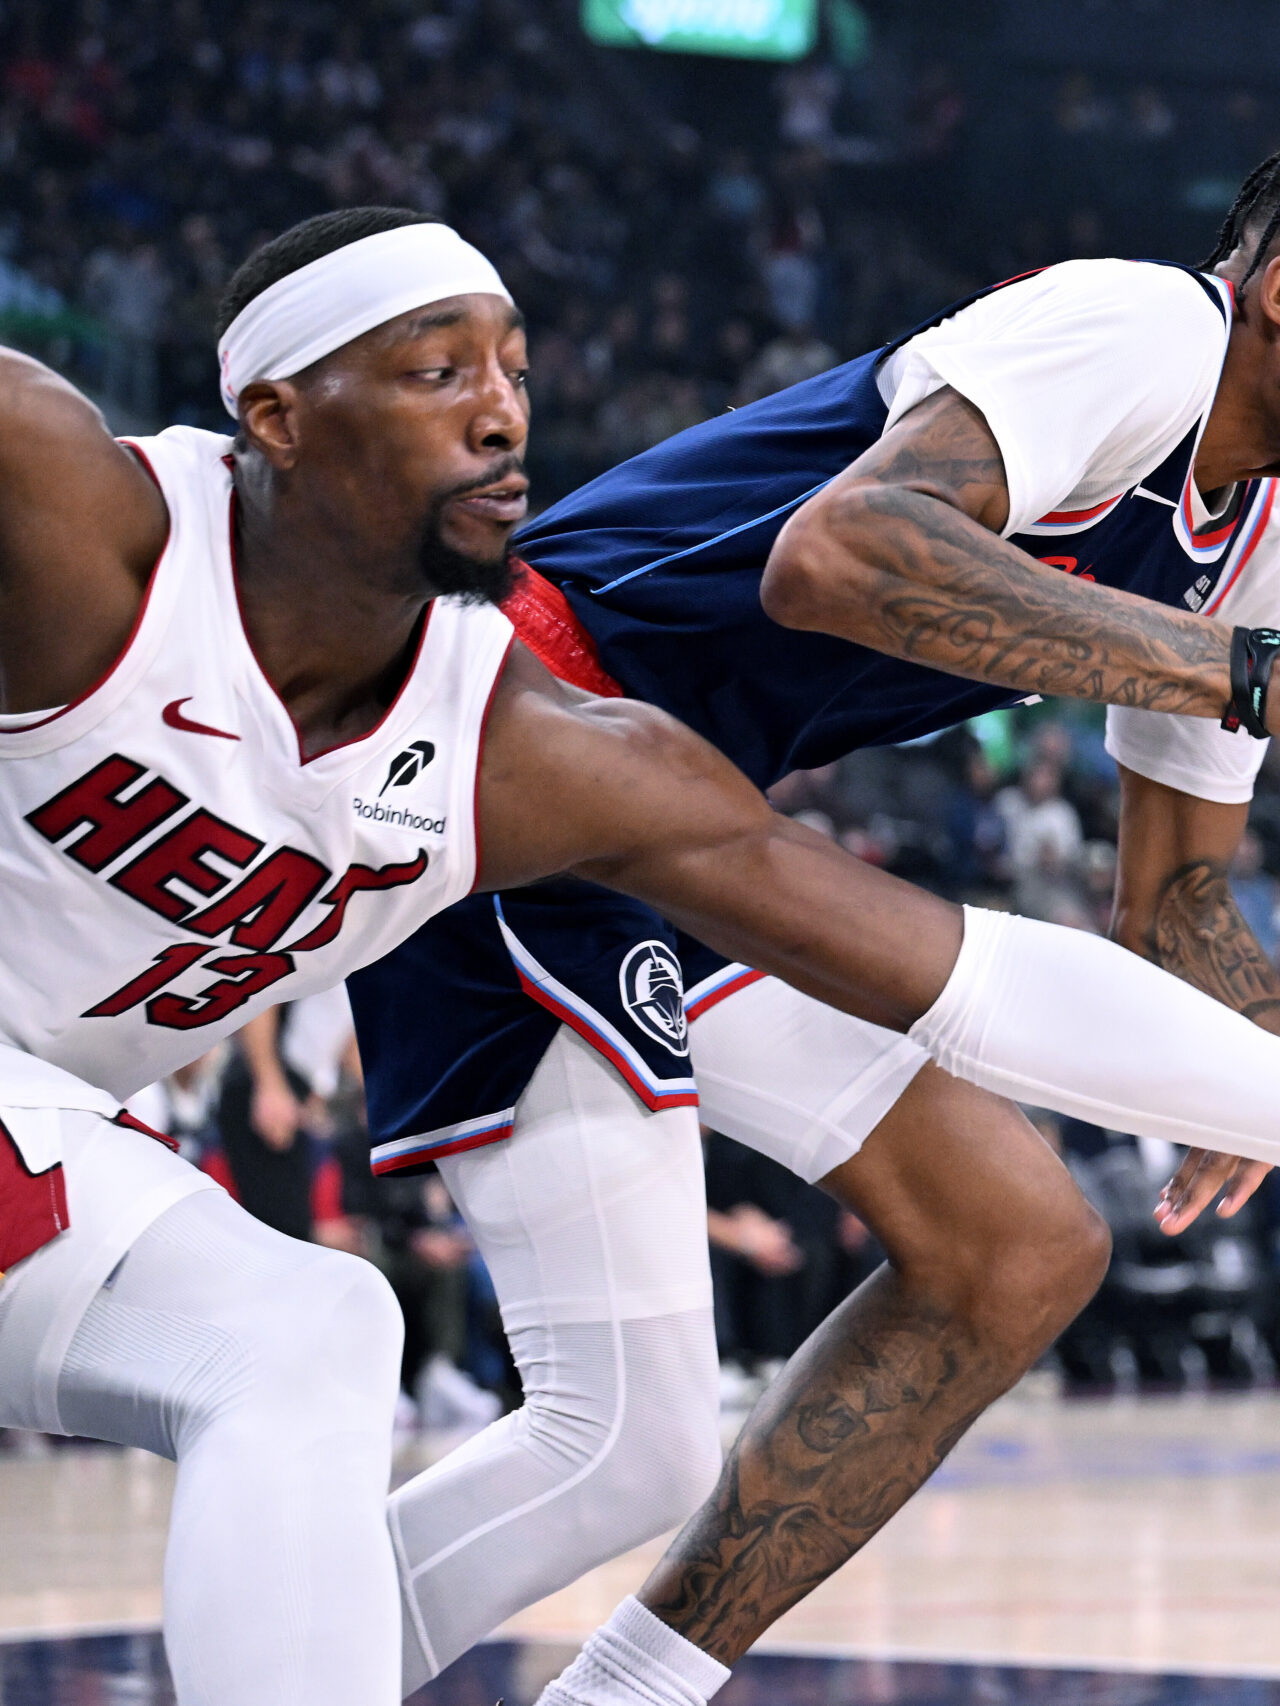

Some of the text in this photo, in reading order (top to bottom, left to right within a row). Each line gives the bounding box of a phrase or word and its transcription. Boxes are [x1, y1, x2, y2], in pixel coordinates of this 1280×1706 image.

[24, 752, 428, 952] HEAT
[353, 797, 447, 835] Robinhood
[79, 942, 297, 1030] 13
